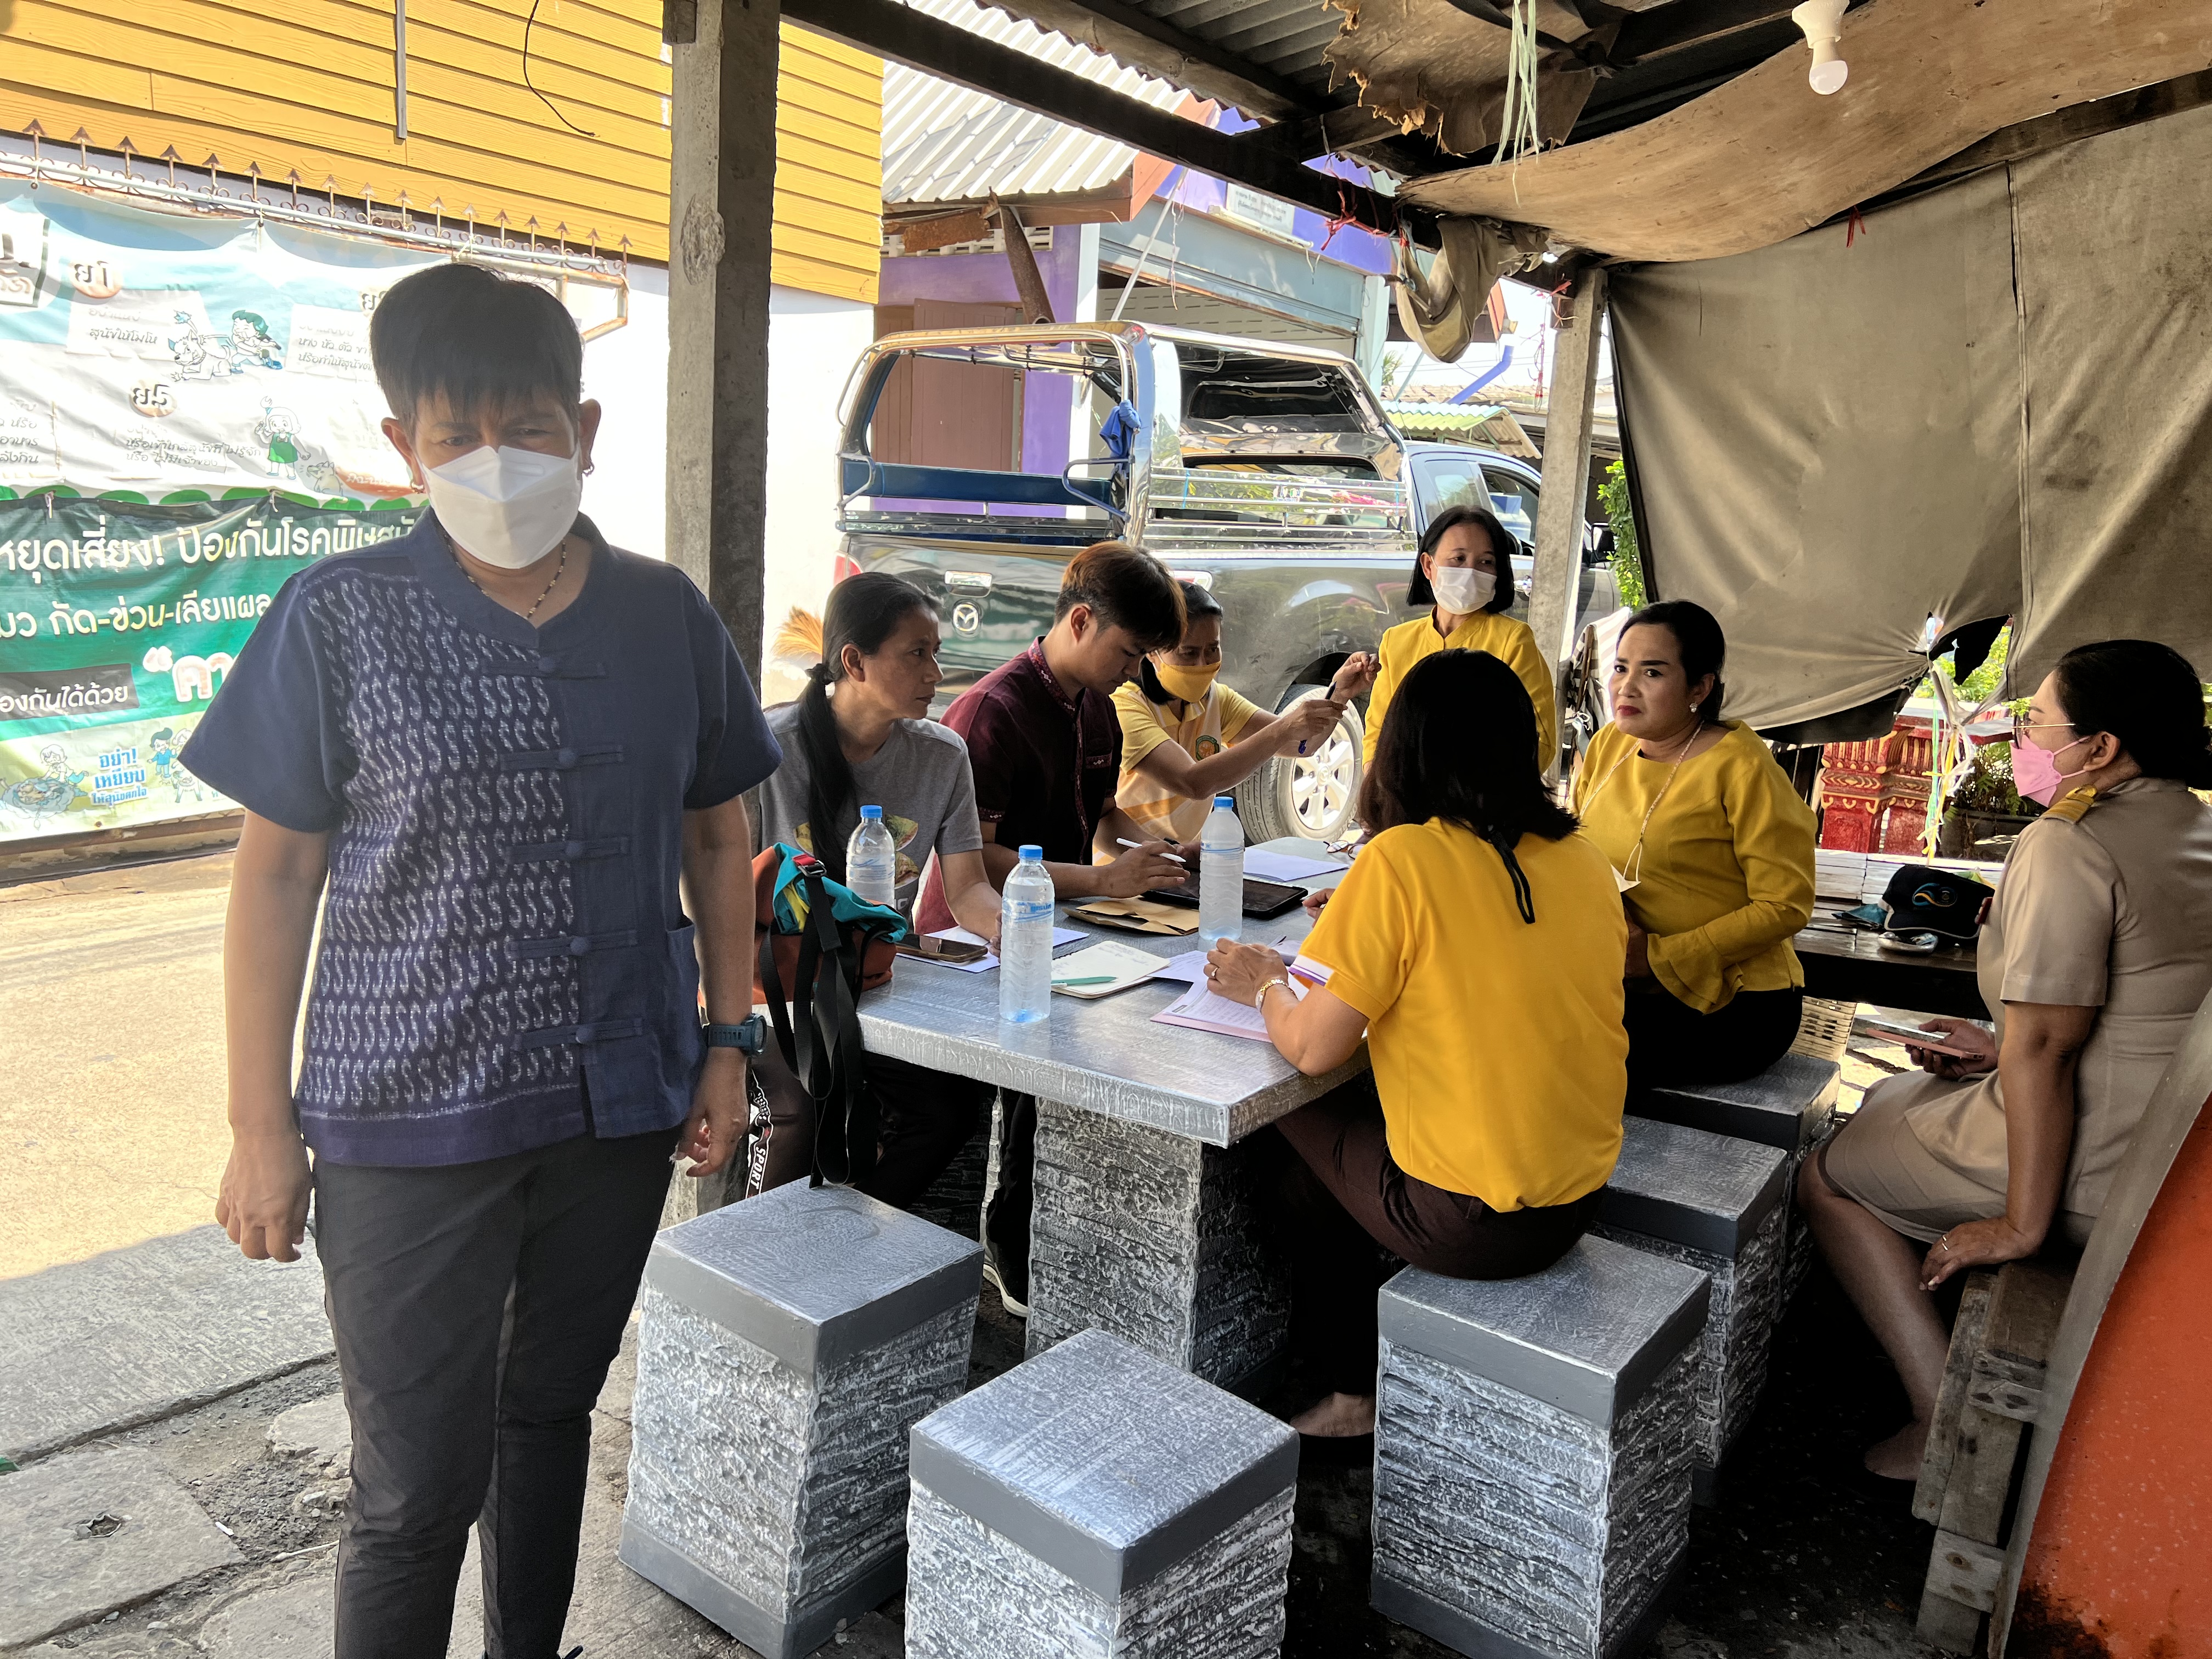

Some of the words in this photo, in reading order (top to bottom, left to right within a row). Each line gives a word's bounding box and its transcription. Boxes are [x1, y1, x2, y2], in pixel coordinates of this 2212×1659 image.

[89, 328, 157, 345] สุนัขให้โมโห
[132, 383, 173, 408] ย5
[99, 748, 137, 768] อย่า!
[95, 768, 145, 789] เหยียบ
[751, 1146, 766, 1190] SPORT
